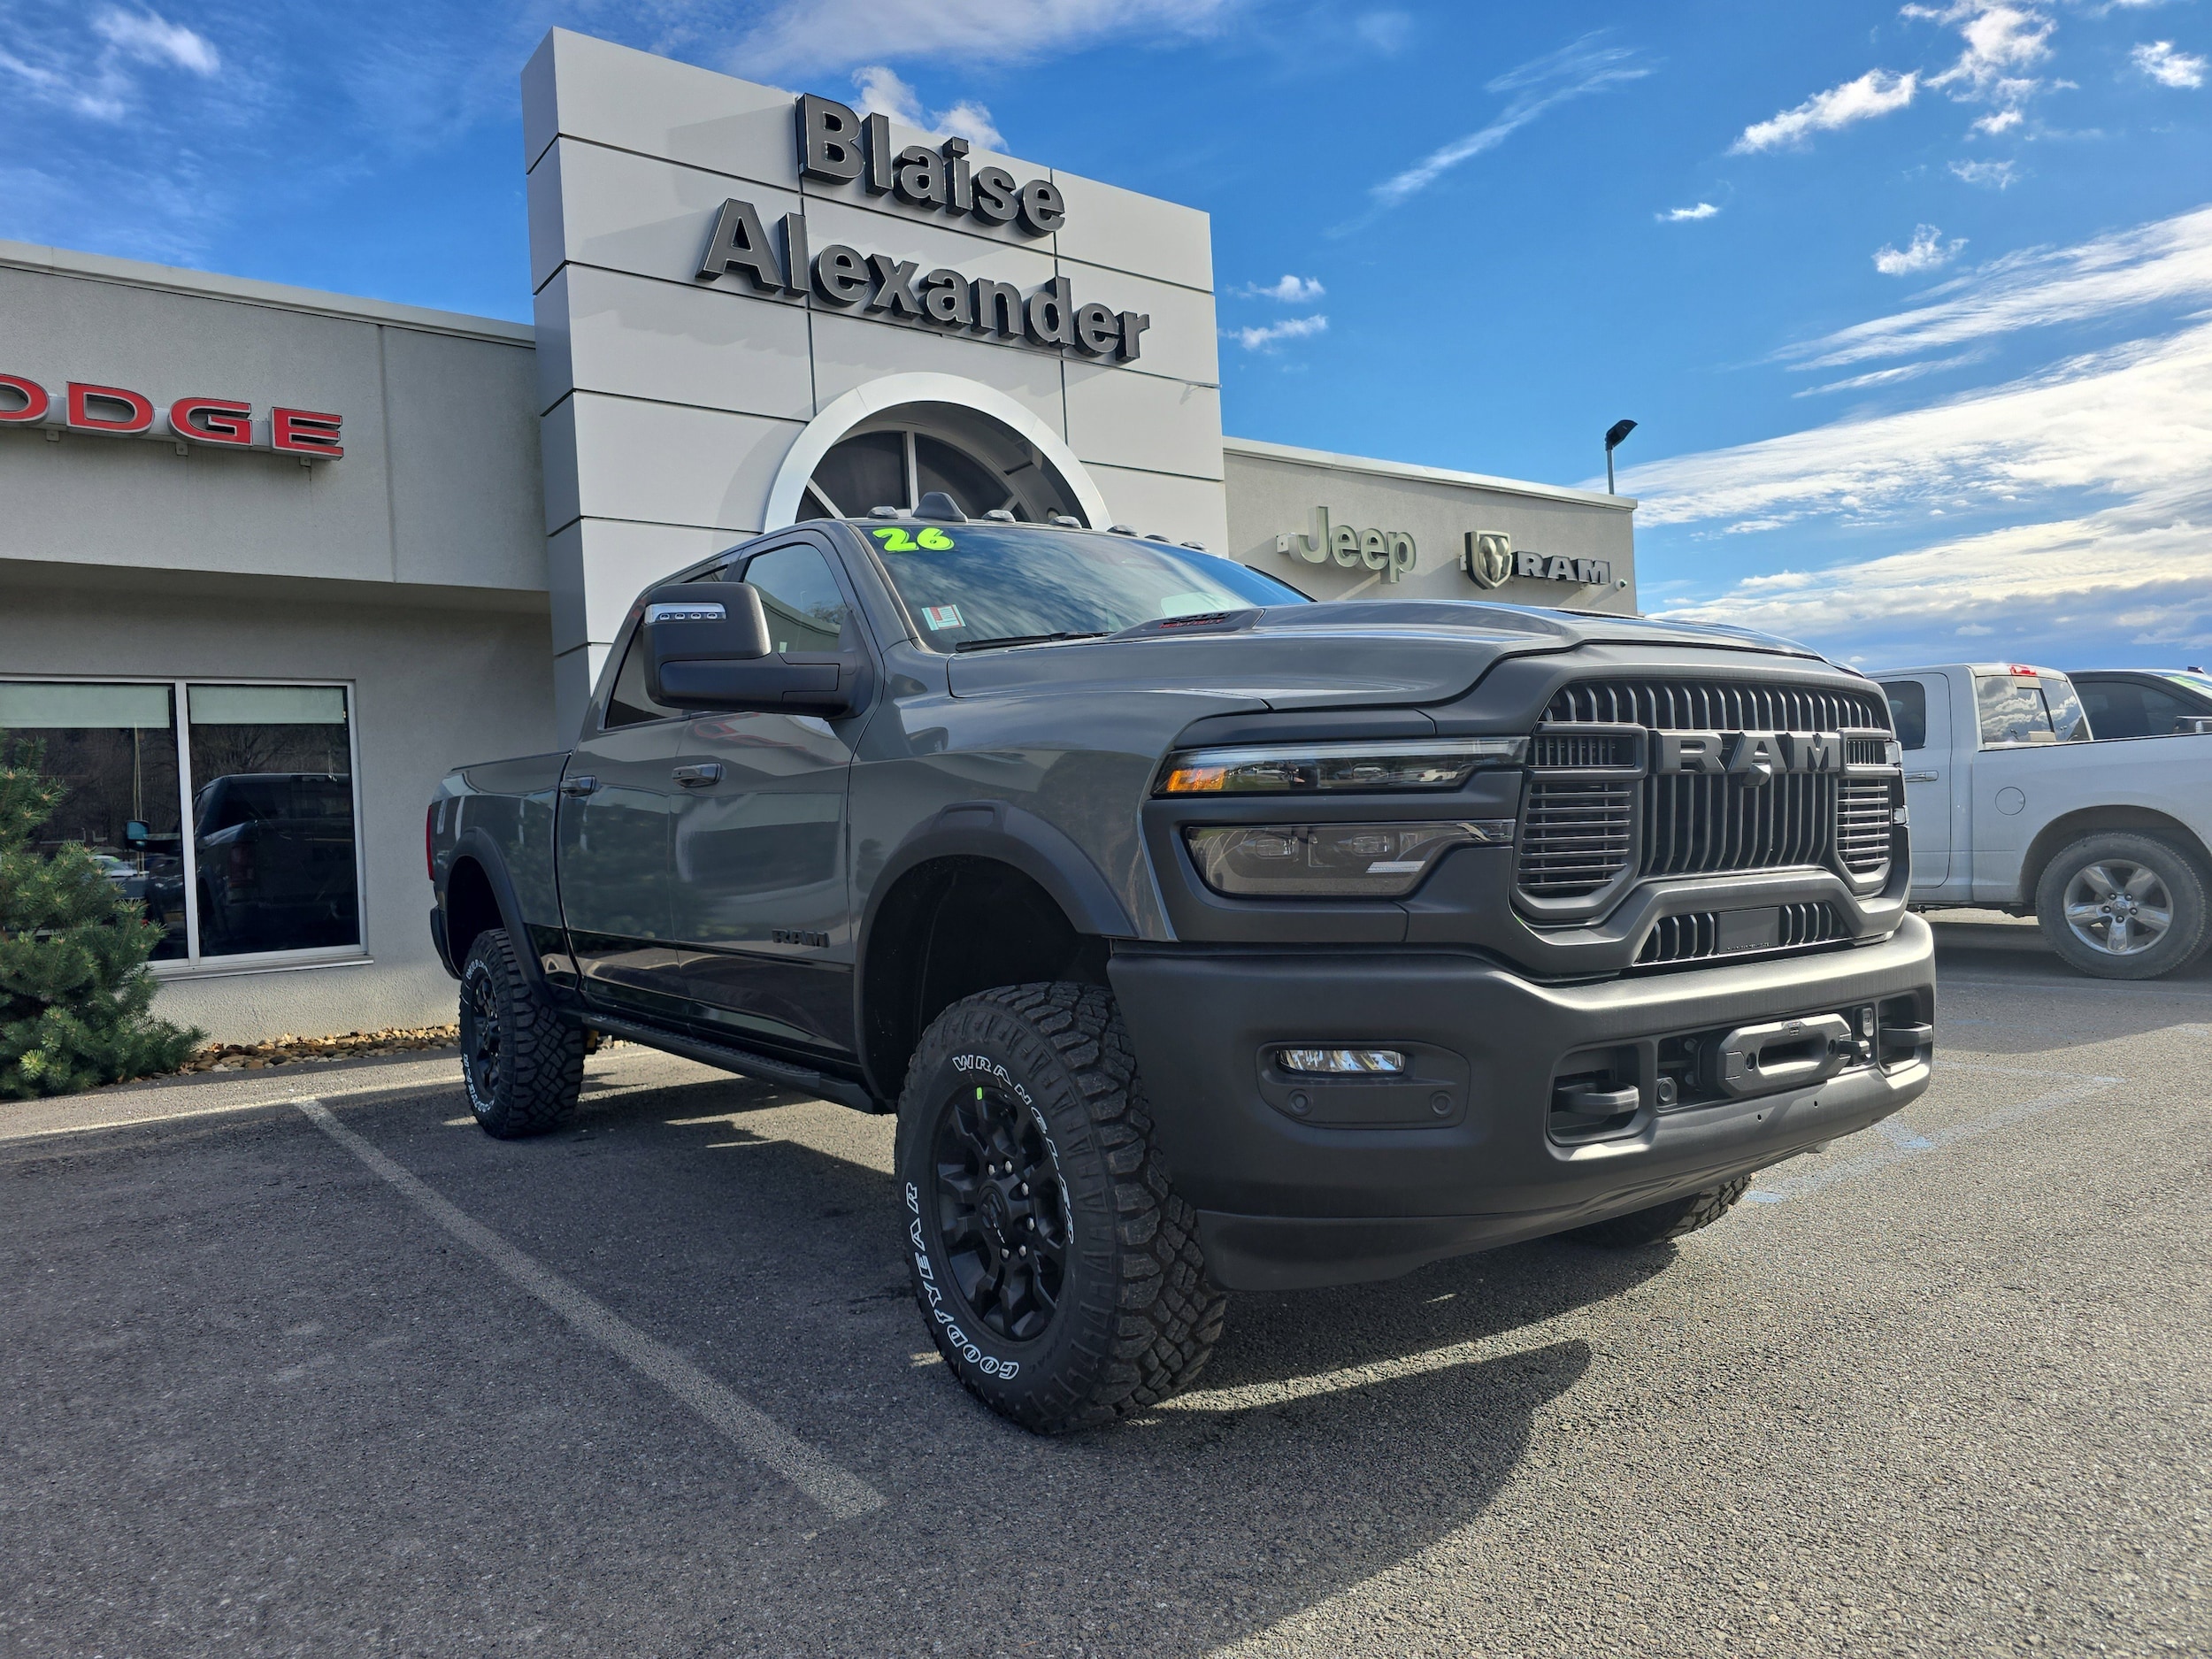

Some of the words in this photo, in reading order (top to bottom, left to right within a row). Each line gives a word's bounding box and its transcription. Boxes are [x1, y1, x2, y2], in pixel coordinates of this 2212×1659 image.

[795, 92, 1065, 237] Blaise
[695, 198, 1150, 364] Alexander
[872, 527, 955, 552] 26
[1288, 505, 1417, 585] Jeep
[1512, 550, 1610, 585] RAM
[1657, 730, 1841, 774] RAM
[772, 928, 830, 948] RAM
[952, 1054, 1075, 1245] WRANGLER
[905, 1182, 1019, 1380] GOODYEAR
